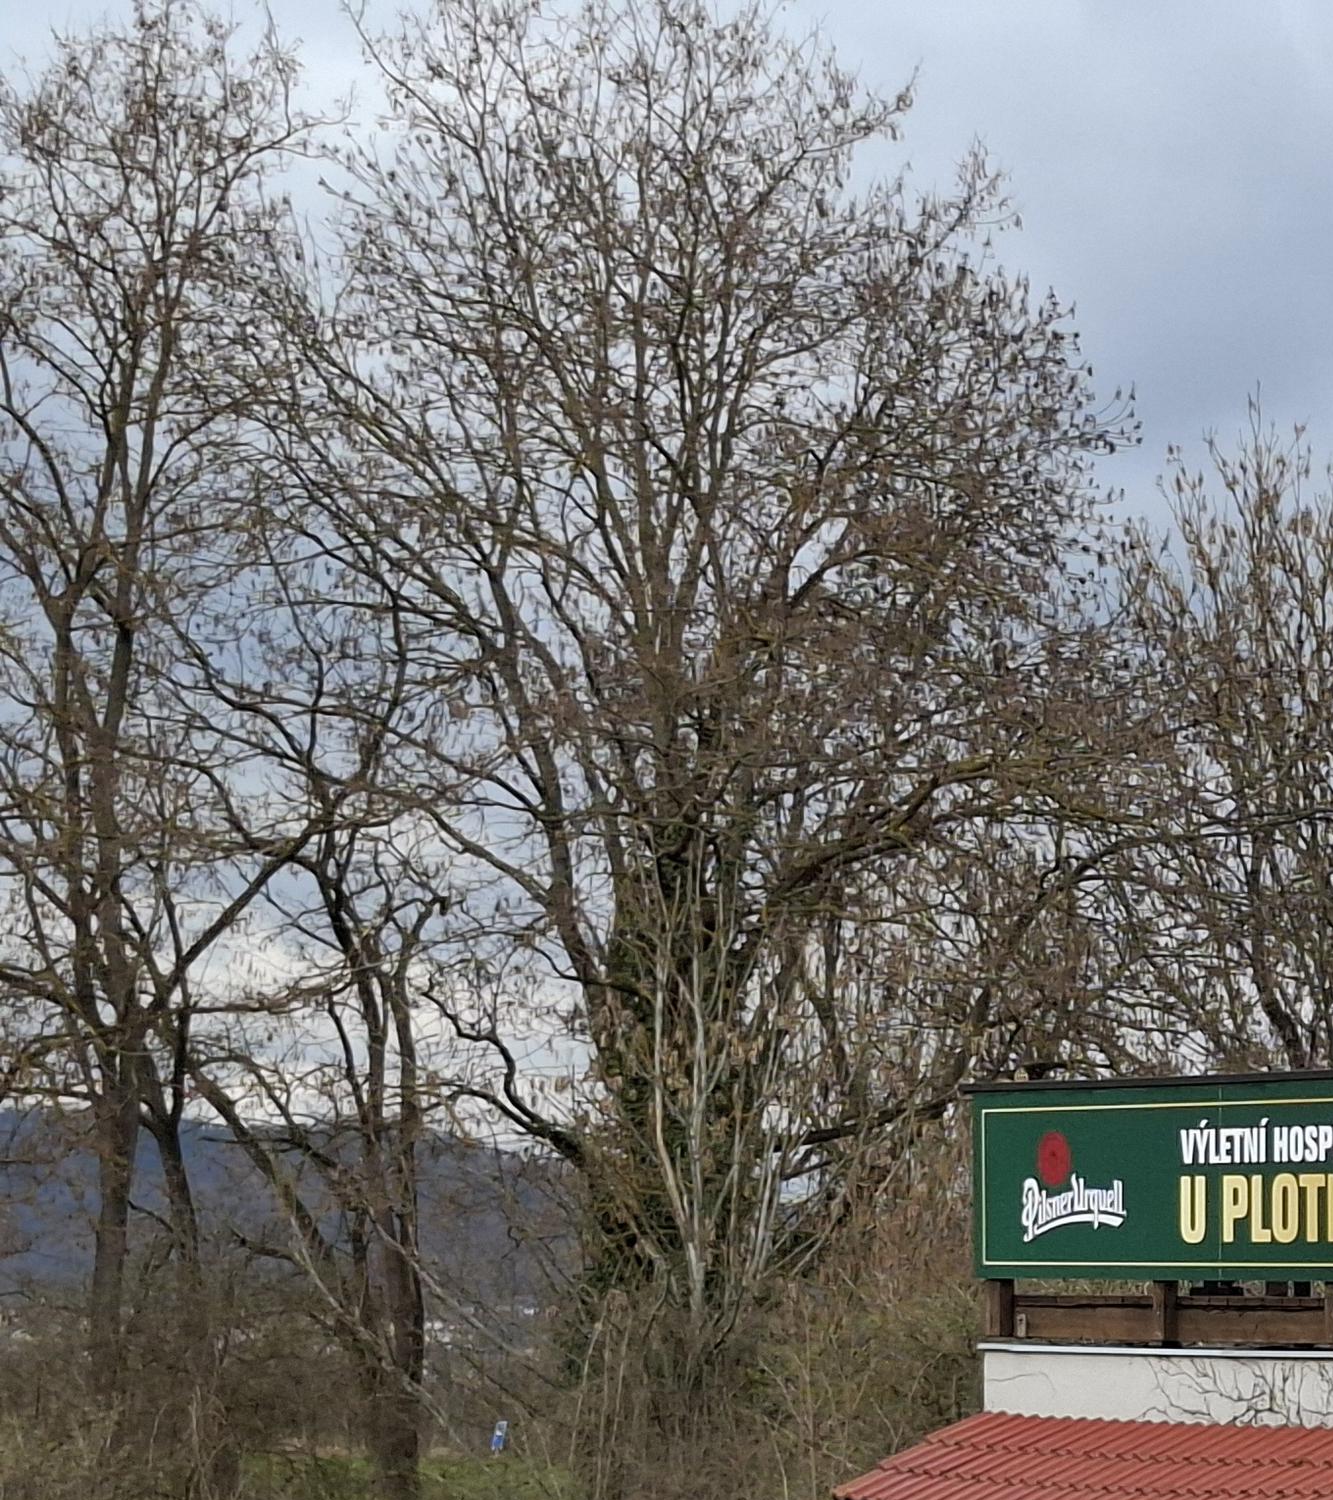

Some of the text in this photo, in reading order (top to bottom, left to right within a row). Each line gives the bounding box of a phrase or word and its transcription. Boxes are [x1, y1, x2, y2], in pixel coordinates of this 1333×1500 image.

[1180, 1118, 1268, 1165] VÝLETNÍ
[1021, 1173, 1127, 1243] Pilsner Urquell
[1179, 1175, 1207, 1244] U
